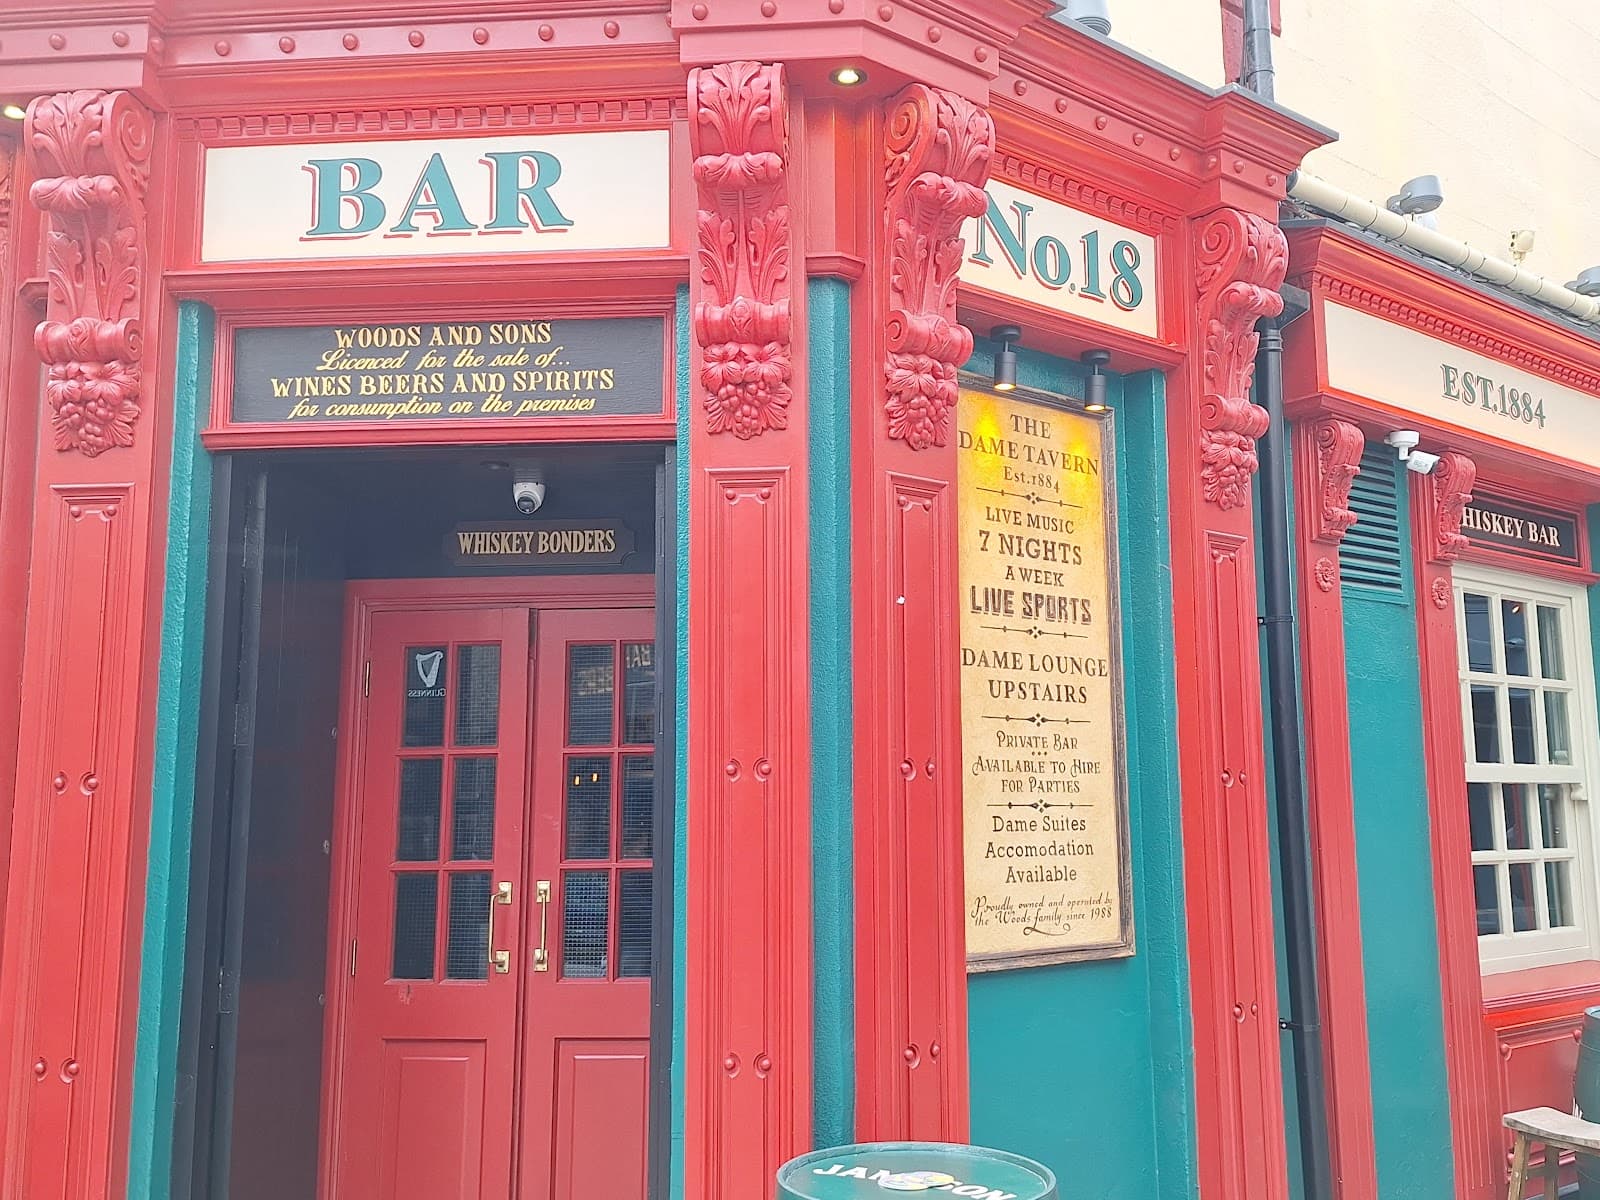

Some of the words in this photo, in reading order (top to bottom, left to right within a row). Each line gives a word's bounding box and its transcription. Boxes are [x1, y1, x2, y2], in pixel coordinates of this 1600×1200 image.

[299, 151, 574, 241] BAR
[968, 191, 1143, 311] No.18
[334, 326, 421, 348] WOODS
[428, 326, 482, 346] AND
[489, 322, 551, 345] SONS
[316, 349, 409, 371] Licenced
[415, 350, 447, 370] for
[453, 349, 485, 367] the
[488, 347, 529, 367] sale
[271, 375, 351, 397] WINES
[360, 373, 444, 395] BEERS
[451, 372, 506, 393] AND
[513, 369, 614, 392] SPIRITS
[1440, 363, 1547, 429] EST.1884
[287, 398, 319, 419] for
[325, 395, 442, 419] consumption
[448, 401, 474, 413] on
[481, 394, 512, 413] the
[513, 394, 596, 416] premises
[1010, 414, 1051, 439] THE
[959, 430, 1019, 460] DAME
[1022, 445, 1099, 476] TAVERN
[1003, 466, 1060, 494] Est.1884
[985, 506, 1022, 526] LIVE
[1027, 513, 1074, 534] MUSIC
[1461, 506, 1524, 539] HISKEY
[1527, 521, 1560, 547] BAR
[457, 531, 534, 554] WHISKEY
[536, 529, 616, 554] BONDERS
[978, 530, 990, 551] 7
[998, 533, 1082, 565] NIGHTS
[1005, 565, 1016, 581] A
[1019, 567, 1064, 587] WEEK
[970, 585, 1015, 617] LIVE
[1022, 591, 1091, 625] SPORTS
[962, 648, 1023, 670] DAME
[1028, 653, 1108, 677] LOUNGE
[988, 680, 1088, 704] UPSTAIRS
[992, 815, 1038, 832] Dame
[1042, 815, 1086, 832] Suites
[985, 839, 1094, 859] Accomodation
[1005, 865, 1077, 883] Available
[971, 895, 1013, 918] Proudly
[1018, 895, 1044, 909] owned
[1048, 893, 1064, 907] and
[1067, 892, 1102, 910] operated
[975, 911, 989, 927] the
[995, 909, 1031, 924] Woods
[1066, 912, 1085, 921] since
[1090, 907, 1112, 921] 1988
